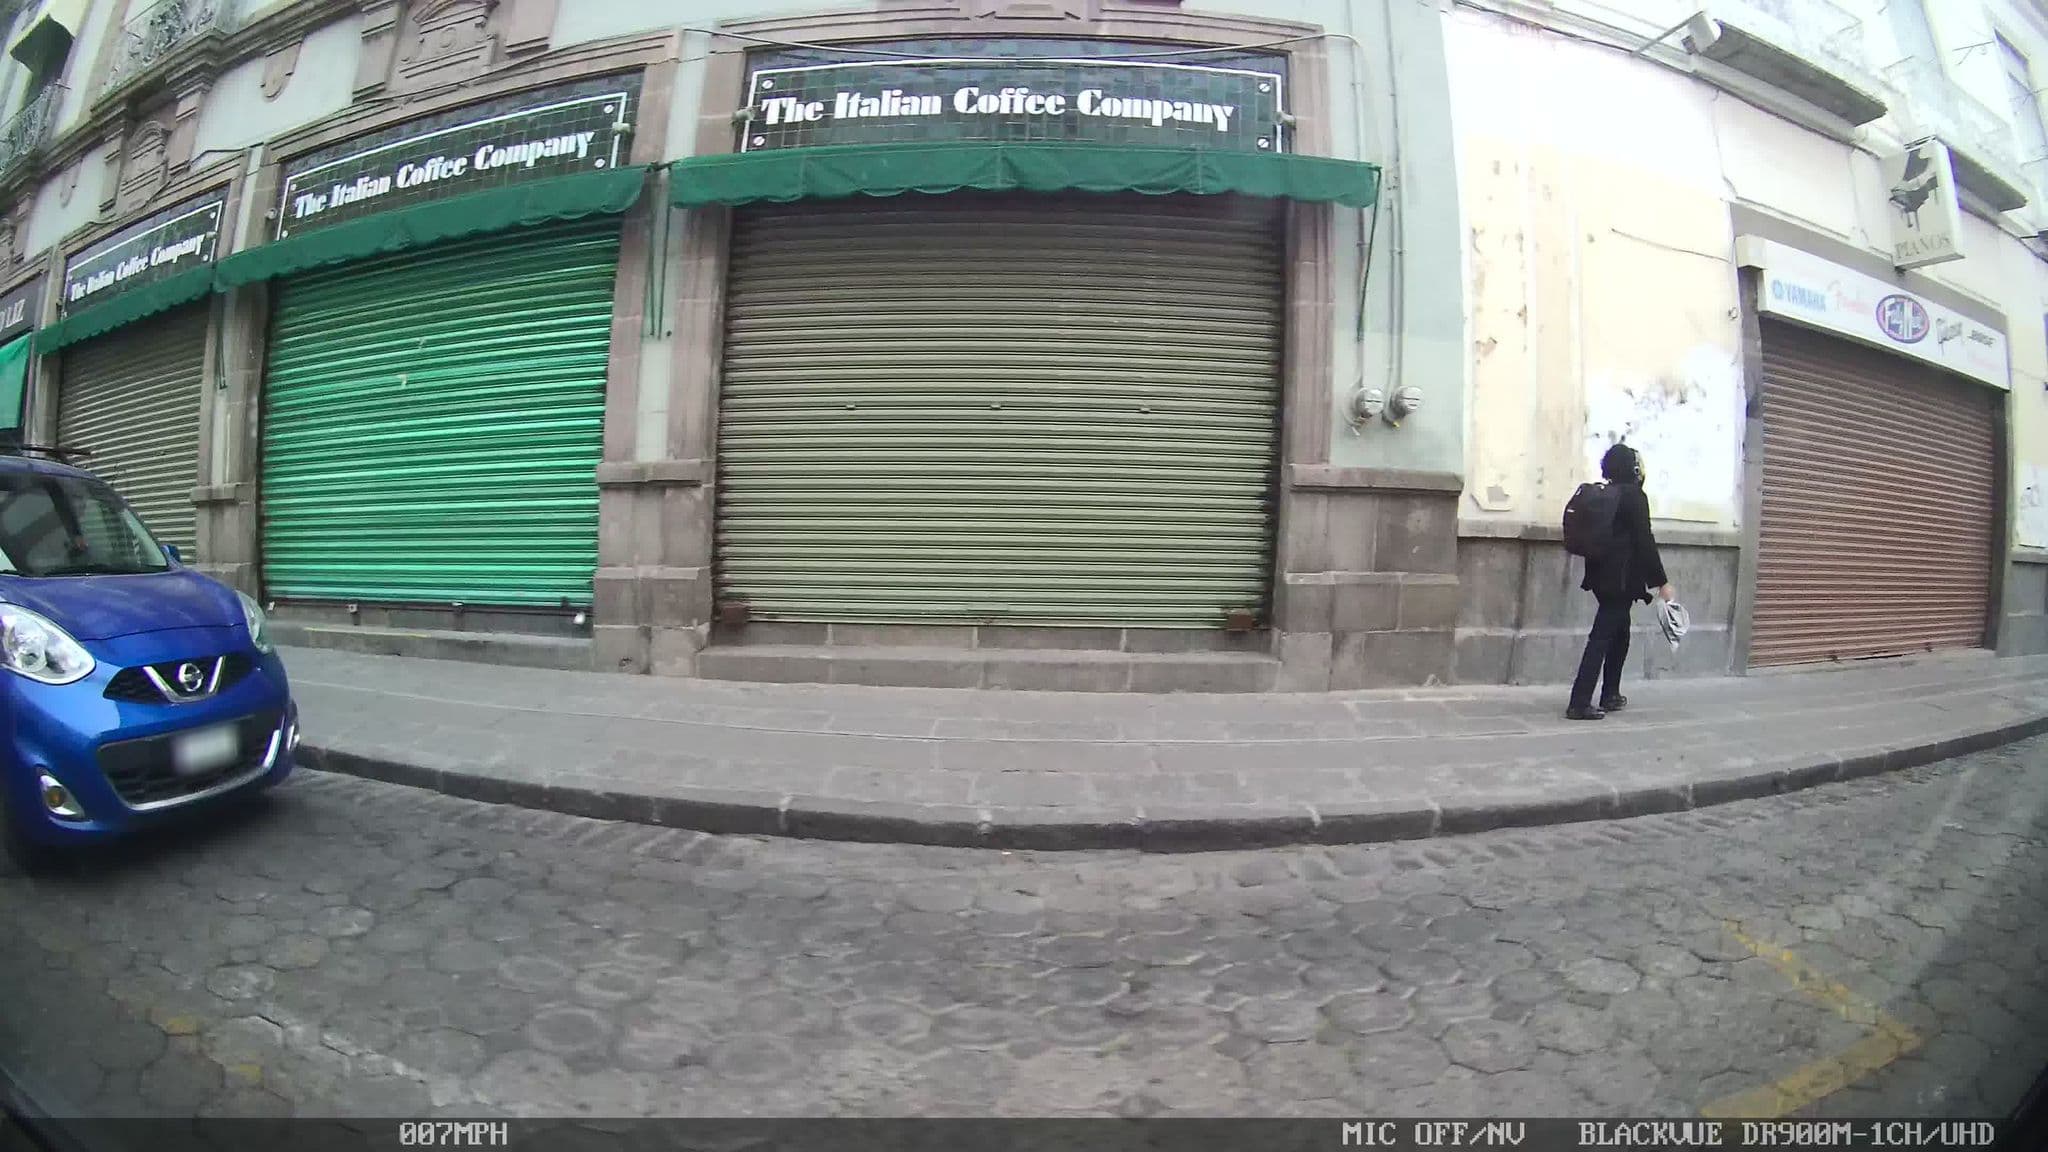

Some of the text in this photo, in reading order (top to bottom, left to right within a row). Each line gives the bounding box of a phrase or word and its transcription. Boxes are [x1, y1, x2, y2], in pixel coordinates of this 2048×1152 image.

[761, 86, 1235, 132] The Italian Coffee Company
[294, 131, 596, 219] The Italian Coffee Company
[71, 234, 206, 302] The Italian Coffee Company
[1895, 232, 1953, 259] PIANOS
